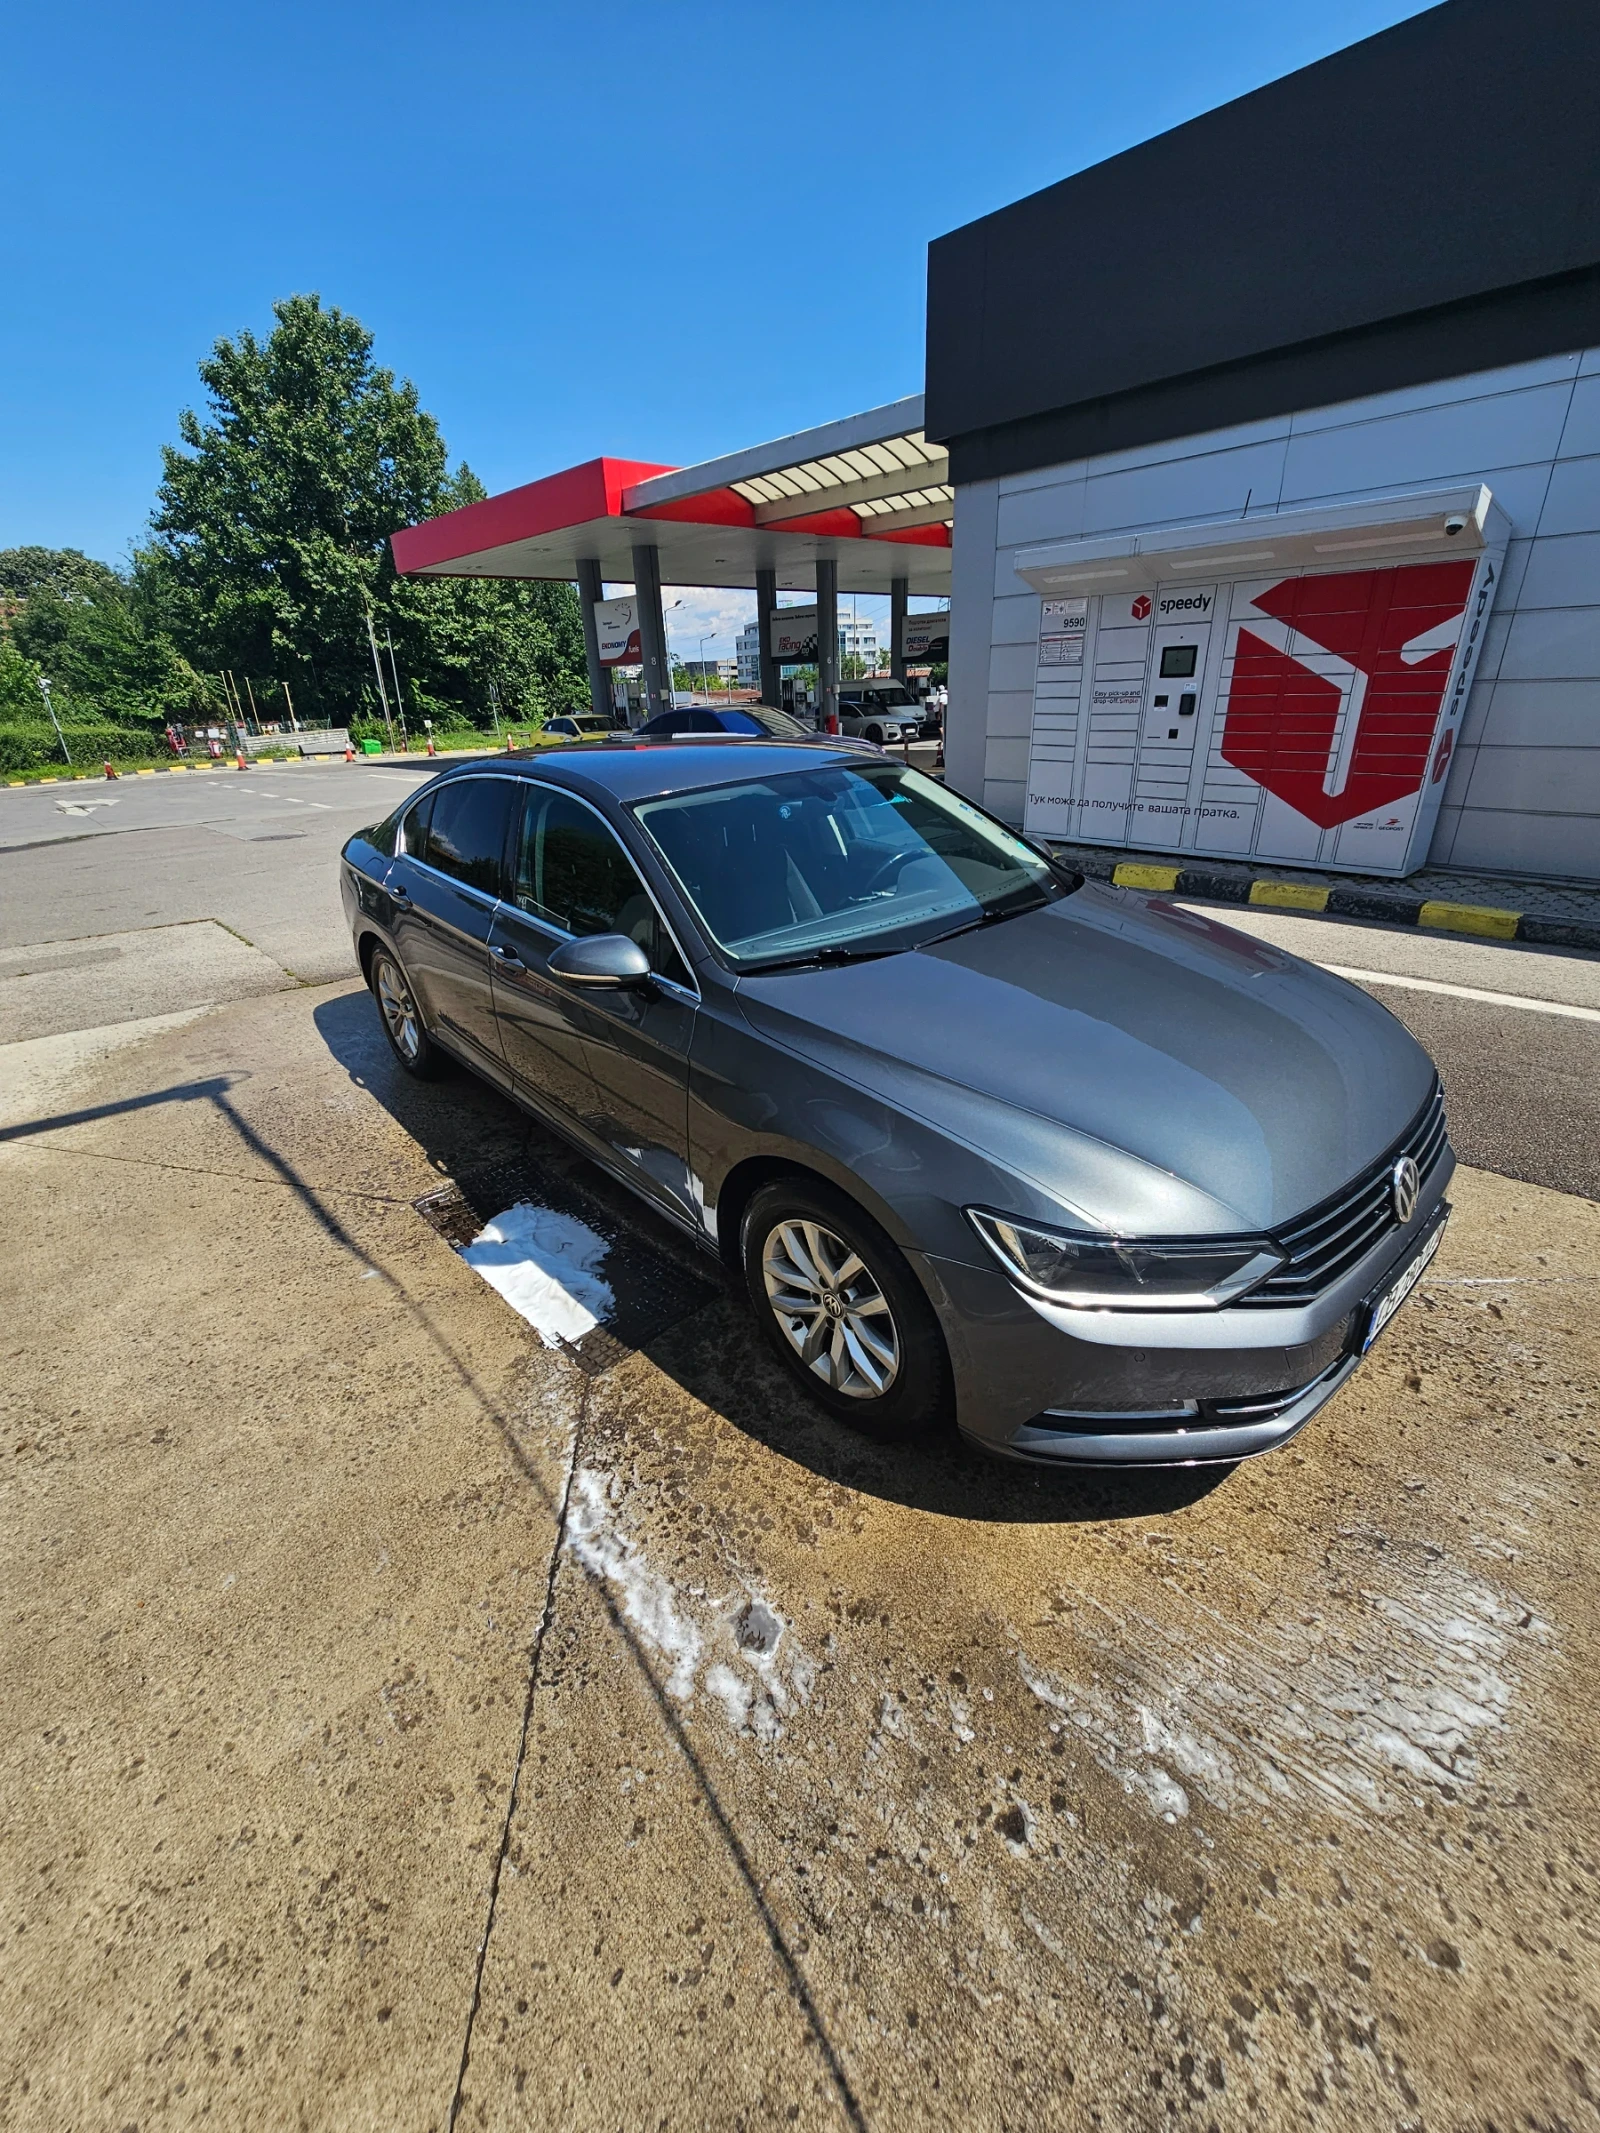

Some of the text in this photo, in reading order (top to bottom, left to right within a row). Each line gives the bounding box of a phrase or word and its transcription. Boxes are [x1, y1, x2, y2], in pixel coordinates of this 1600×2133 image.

[1159, 594, 1211, 614] speedy
[1063, 617, 1085, 628] 9590
[906, 636, 930, 644] DIESEL
[1450, 562, 1495, 716] speedy
[602, 641, 626, 649] EKONOMY
[779, 641, 801, 650] racing
[651, 656, 657, 666] 8
[826, 656, 832, 664] 6
[1094, 690, 1107, 698] Easy
[1028, 793, 1240, 820] Тук може да получите вашата пратка.
